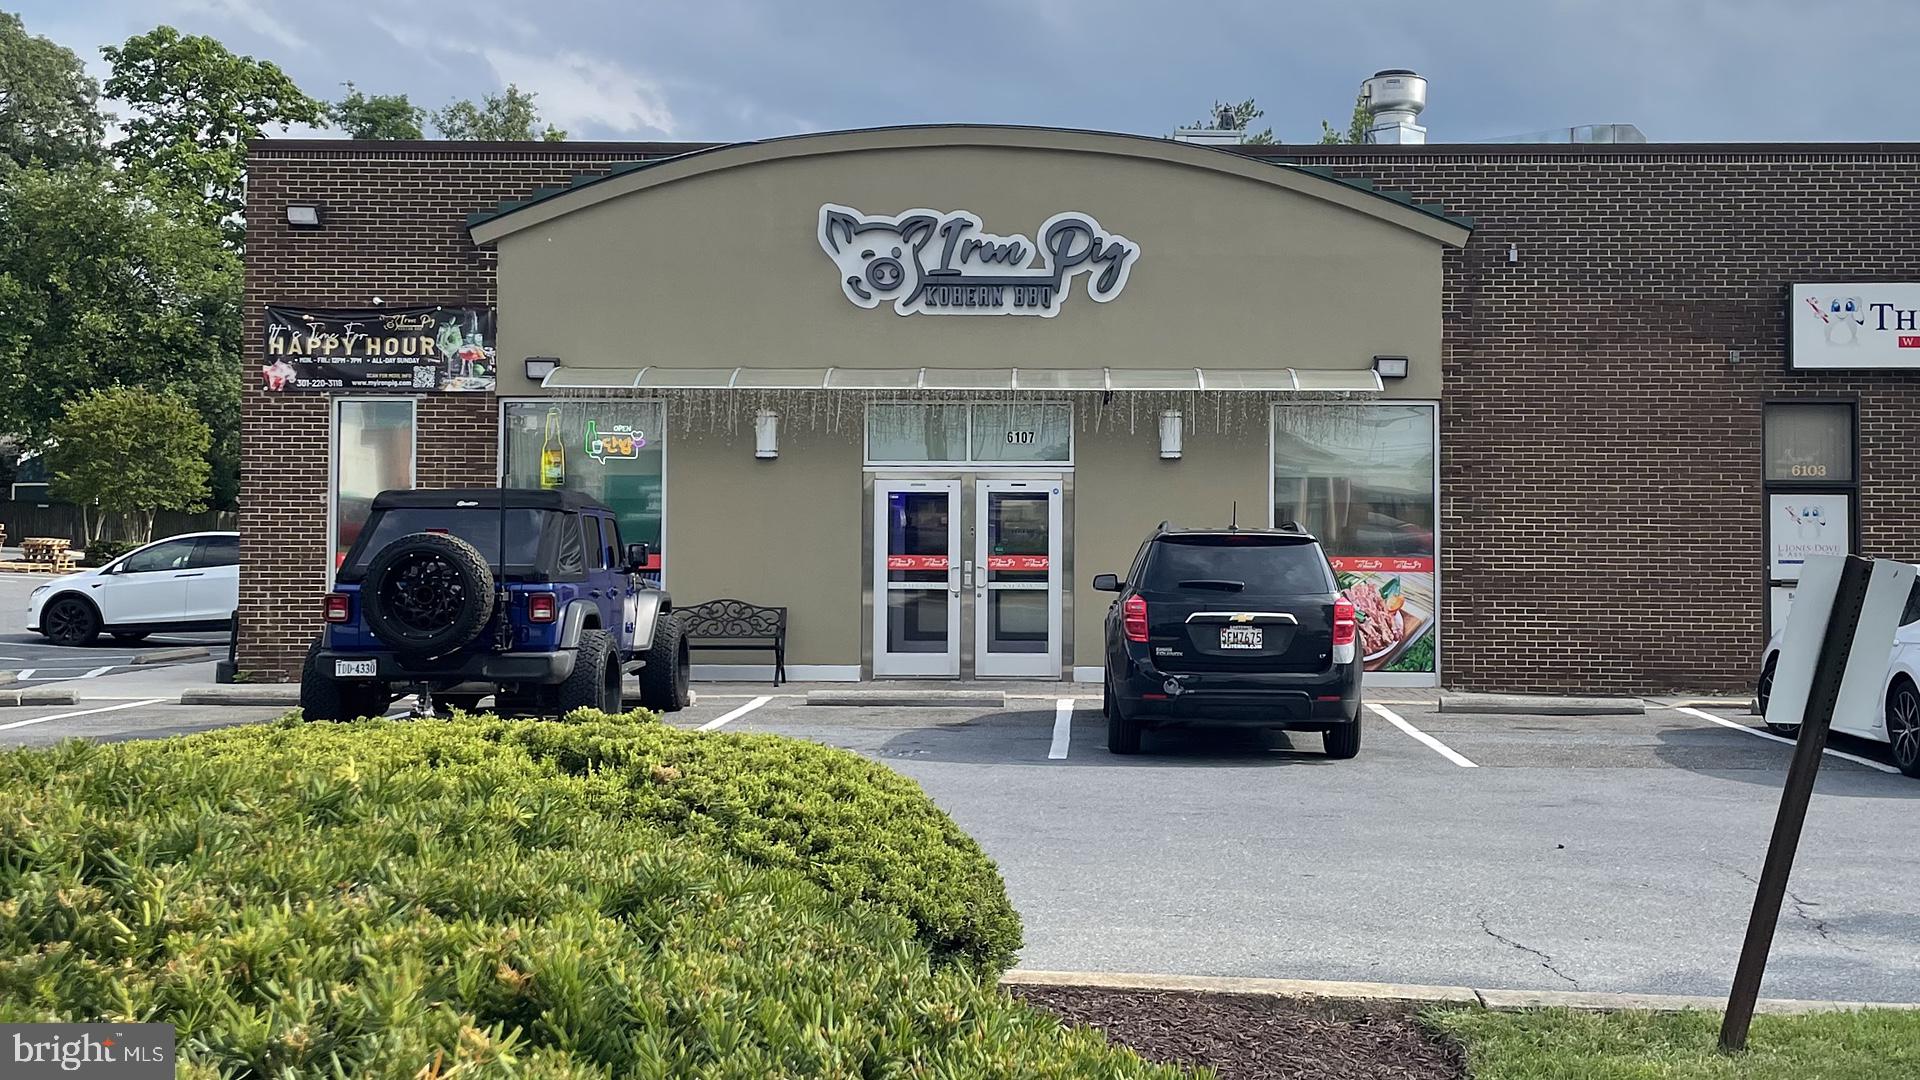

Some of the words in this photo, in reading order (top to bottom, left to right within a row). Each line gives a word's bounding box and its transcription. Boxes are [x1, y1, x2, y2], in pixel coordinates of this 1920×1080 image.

[928, 217, 1027, 276] Iron
[1045, 218, 1131, 294] Pig
[925, 286, 1004, 307] KOREAN
[1013, 286, 1051, 309] BBQ
[1869, 303, 1920, 331] TH
[306, 322, 339, 341] Time
[269, 336, 353, 355] HAPPY
[365, 336, 435, 355] HOUR
[613, 424, 632, 432] OPEN
[1006, 431, 1036, 444] 6107
[1791, 464, 1827, 477] 6103
